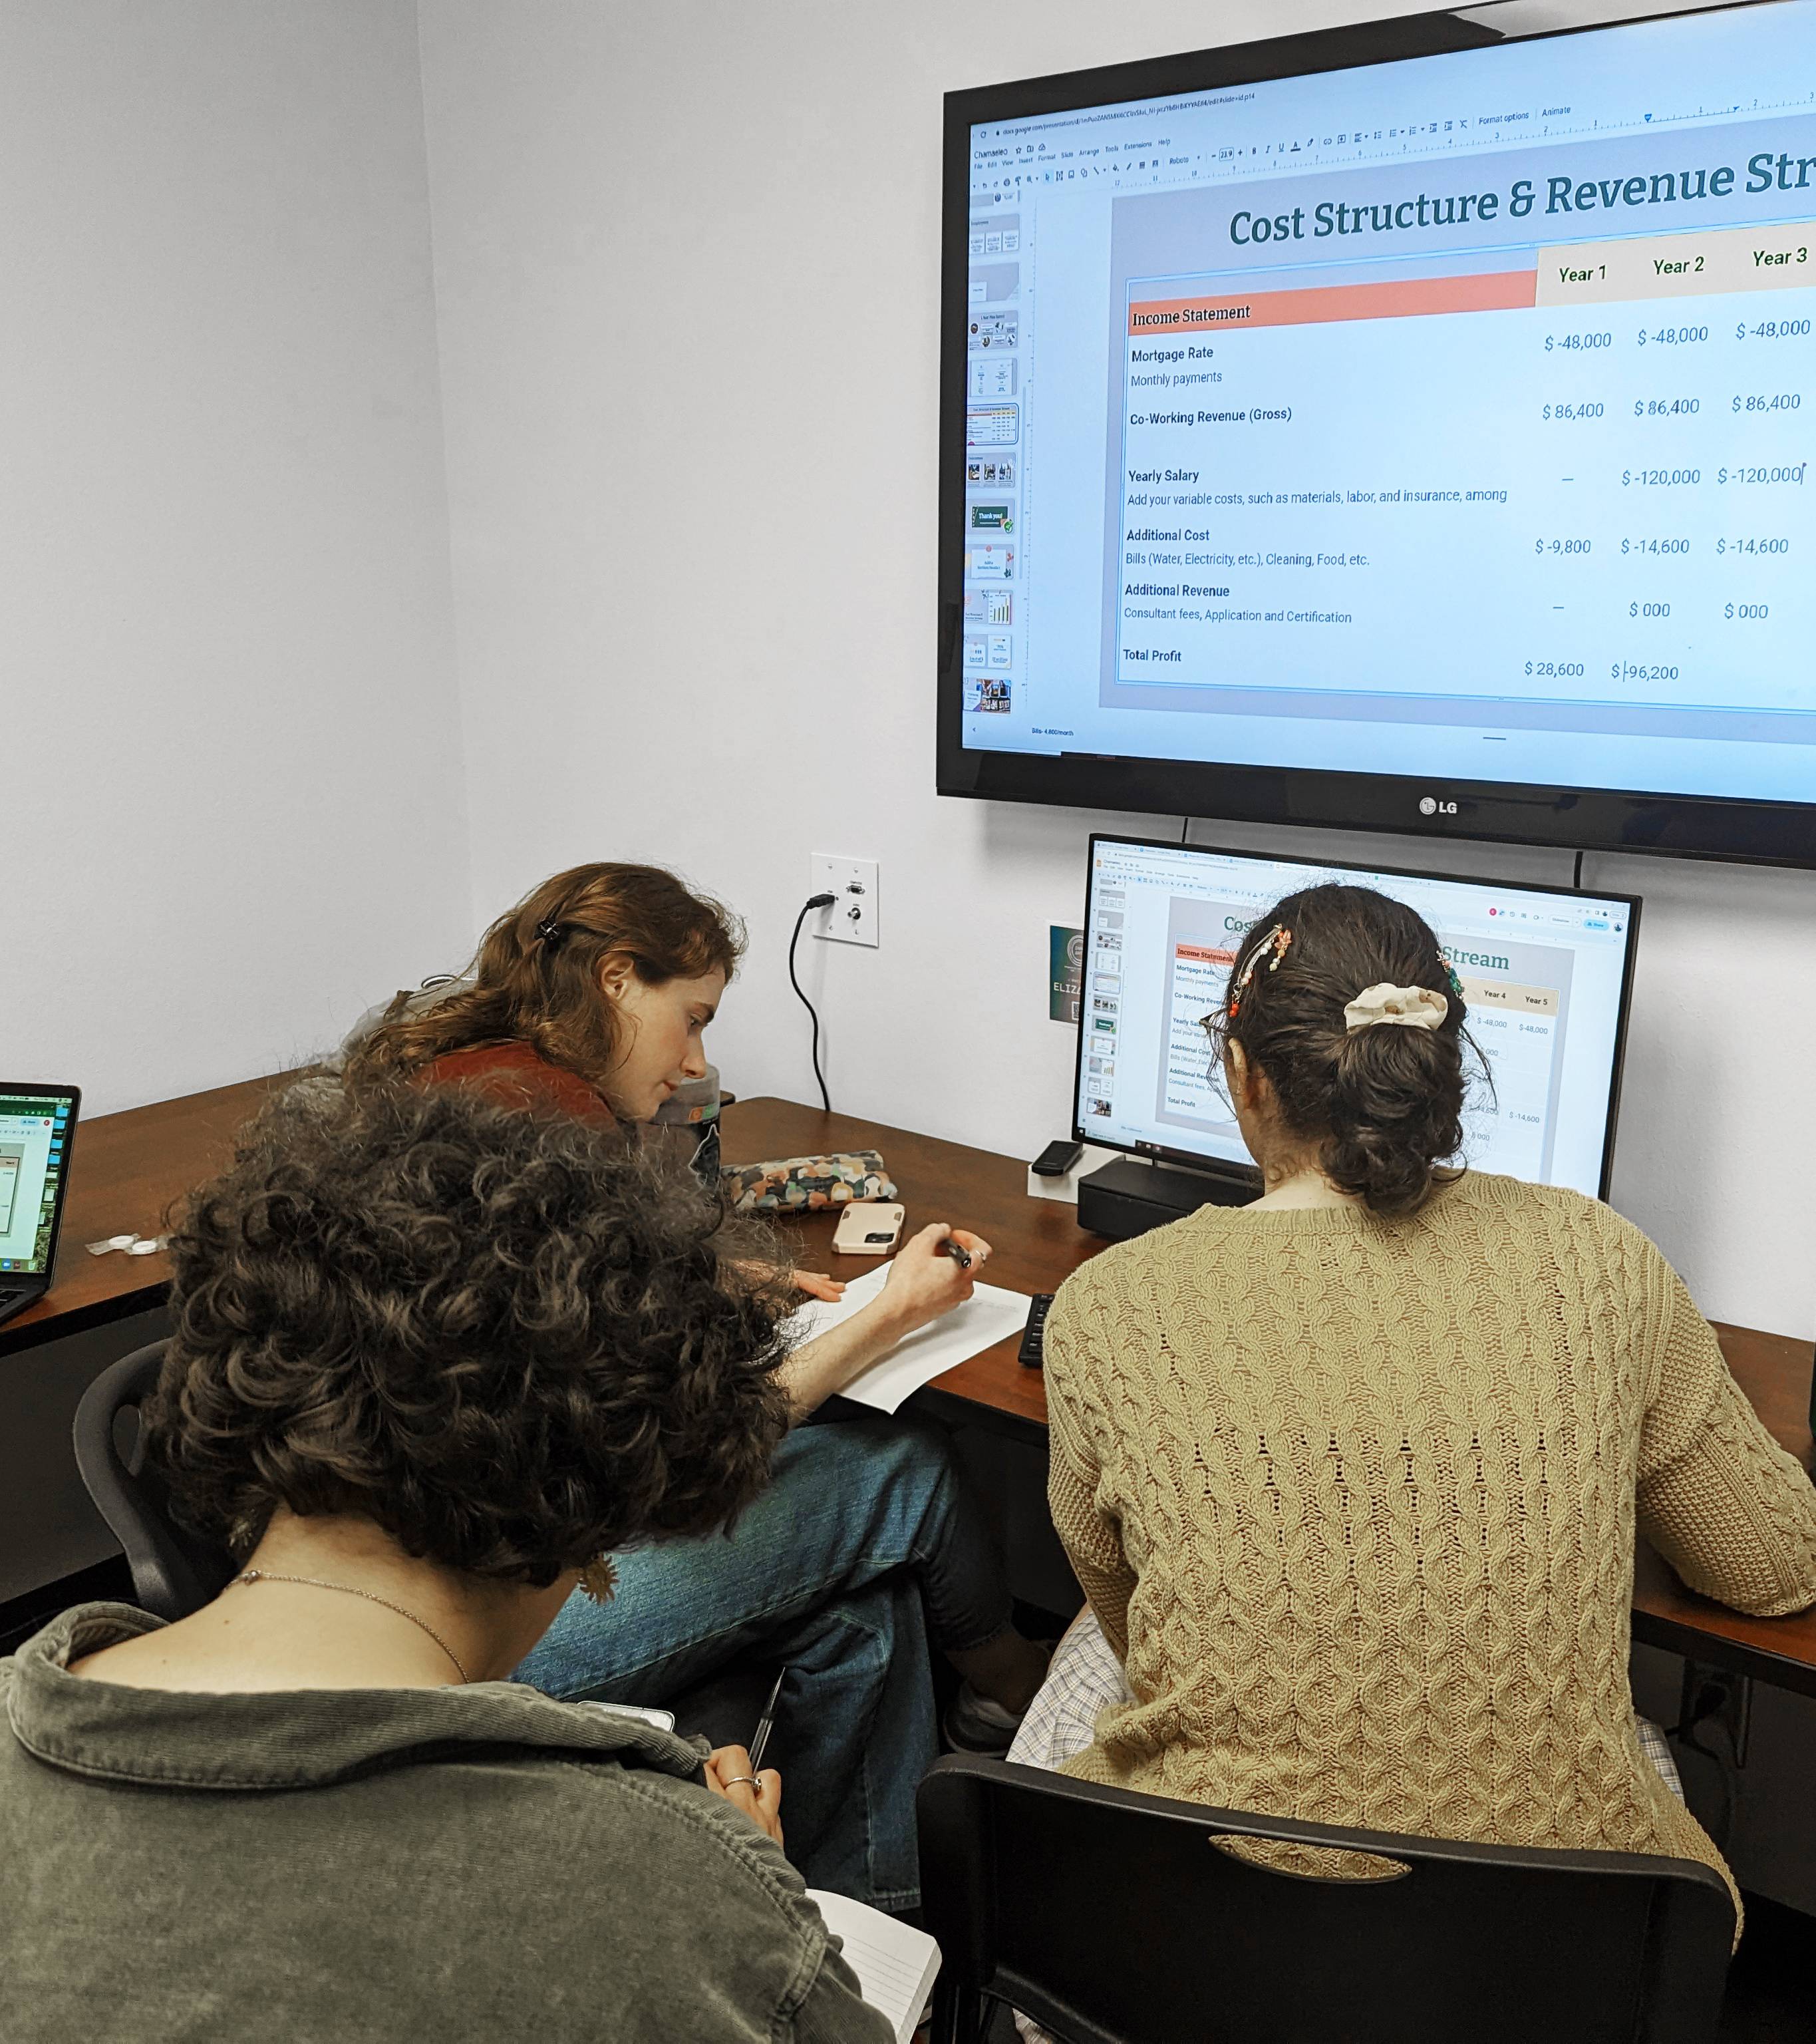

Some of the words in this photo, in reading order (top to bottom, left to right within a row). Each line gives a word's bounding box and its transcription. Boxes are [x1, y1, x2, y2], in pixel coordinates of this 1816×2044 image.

[1478, 116, 1503, 125] Format
[1505, 114, 1529, 125] options
[1542, 106, 1571, 118] Animate
[1079, 148, 1100, 157] Arrange
[1124, 141, 1152, 150] Extensions
[1169, 156, 1189, 166] Roboto
[1229, 204, 1304, 245] Cost
[1313, 192, 1499, 238] Structure
[1509, 180, 1535, 217] &
[1545, 164, 1735, 214] Revenue
[1653, 259, 1688, 275] Year
[1693, 256, 1704, 273] 2
[1753, 251, 1791, 268] Year
[1796, 247, 1807, 263] 3
[1559, 267, 1592, 283] Year
[1598, 265, 1607, 280] 1
[1132, 312, 1180, 326] Income
[1182, 305, 1251, 323] Statement
[1638, 329, 1647, 346] $
[1650, 327, 1708, 345] -48,000
[1736, 322, 1745, 340] $
[1749, 319, 1811, 338] -48,000
[1545, 335, 1553, 351] $
[1557, 333, 1612, 351] -48,000
[1132, 349, 1185, 363] Mortgage
[1188, 347, 1214, 359] Rate
[1131, 373, 1170, 388] Monthly
[1173, 371, 1223, 387] payments
[1634, 400, 1643, 417] $
[1648, 399, 1700, 417] 86,400
[1732, 395, 1741, 413] $
[1745, 394, 1801, 412] 86,400
[1130, 411, 1194, 426] Co-Working
[1197, 411, 1246, 423] Revenue
[1249, 407, 1292, 423] (Gross)
[1543, 403, 1551, 421] $
[1555, 403, 1604, 420] 86,400
[1128, 470, 1162, 484] Yearly
[1164, 469, 1199, 484] Salary
[1622, 469, 1630, 486] $
[1634, 469, 1701, 486] -120,000
[1718, 467, 1728, 484] $
[1731, 467, 1801, 485] -120,000
[1128, 494, 1147, 506] Add
[1149, 496, 1171, 508] your
[1173, 493, 1212, 505] variable
[1214, 493, 1245, 506] costs,
[1247, 492, 1273, 504] such
[1275, 494, 1288, 504] as
[1291, 490, 1344, 504] materials,
[1346, 490, 1376, 504] labor,
[1379, 490, 1400, 502] and
[1404, 489, 1463, 503] insurance,
[1465, 490, 1507, 503] among
[1126, 529, 1181, 541] Additional
[1184, 530, 1210, 541] Cost
[1535, 538, 1543, 555] $
[1547, 540, 1591, 556] -9,800
[1621, 538, 1630, 555] $
[1634, 539, 1690, 556] -14,600
[1716, 538, 1726, 555] $
[1730, 539, 1789, 556] -14,600
[1126, 553, 1146, 564] Bills
[1148, 553, 1183, 567] (Water,
[1185, 553, 1235, 568] Electricity,
[1237, 553, 1263, 568] etc.),
[1265, 554, 1314, 568] Cleaning,
[1317, 553, 1347, 567] Food,
[1349, 555, 1370, 566] etc.
[1125, 584, 1179, 596] Additional
[1182, 585, 1230, 597] Revenue
[1124, 607, 1176, 619] Consultant
[1179, 608, 1203, 621] fees,
[1205, 609, 1261, 623] Application
[1265, 610, 1284, 621] and
[1286, 611, 1352, 623] Certification
[1629, 601, 1638, 618] $
[1642, 603, 1670, 617] 000
[1724, 602, 1734, 619] $
[1738, 604, 1769, 619] 000
[1123, 649, 1149, 661] Total
[1151, 650, 1182, 662] Profit
[1525, 661, 1533, 677] $
[1536, 662, 1585, 678] 28,600
[1611, 664, 1620, 679] $
[1438, 801, 1457, 814] LG
[1224, 916, 1251, 933] Cos
[1177, 948, 1200, 957] Income
[1442, 945, 1509, 970] Stream
[1177, 965, 1202, 975] Mortgage
[1175, 975, 1195, 984] Monthly
[1195, 979, 1219, 987] payments
[1174, 993, 1205, 1003] Co-Working
[1484, 990, 1499, 999] Year
[1525, 996, 1541, 1005] Year
[1173, 1017, 1189, 1026] Yearly
[1483, 1018, 1507, 1029] -48,000
[1171, 1043, 1197, 1053] Additional
[1169, 1068, 1196, 1077] Additional
[1168, 1078, 1194, 1088] Consultant
[1181, 1099, 1196, 1108] Profit
[1515, 1112, 1540, 1123] -14,600
